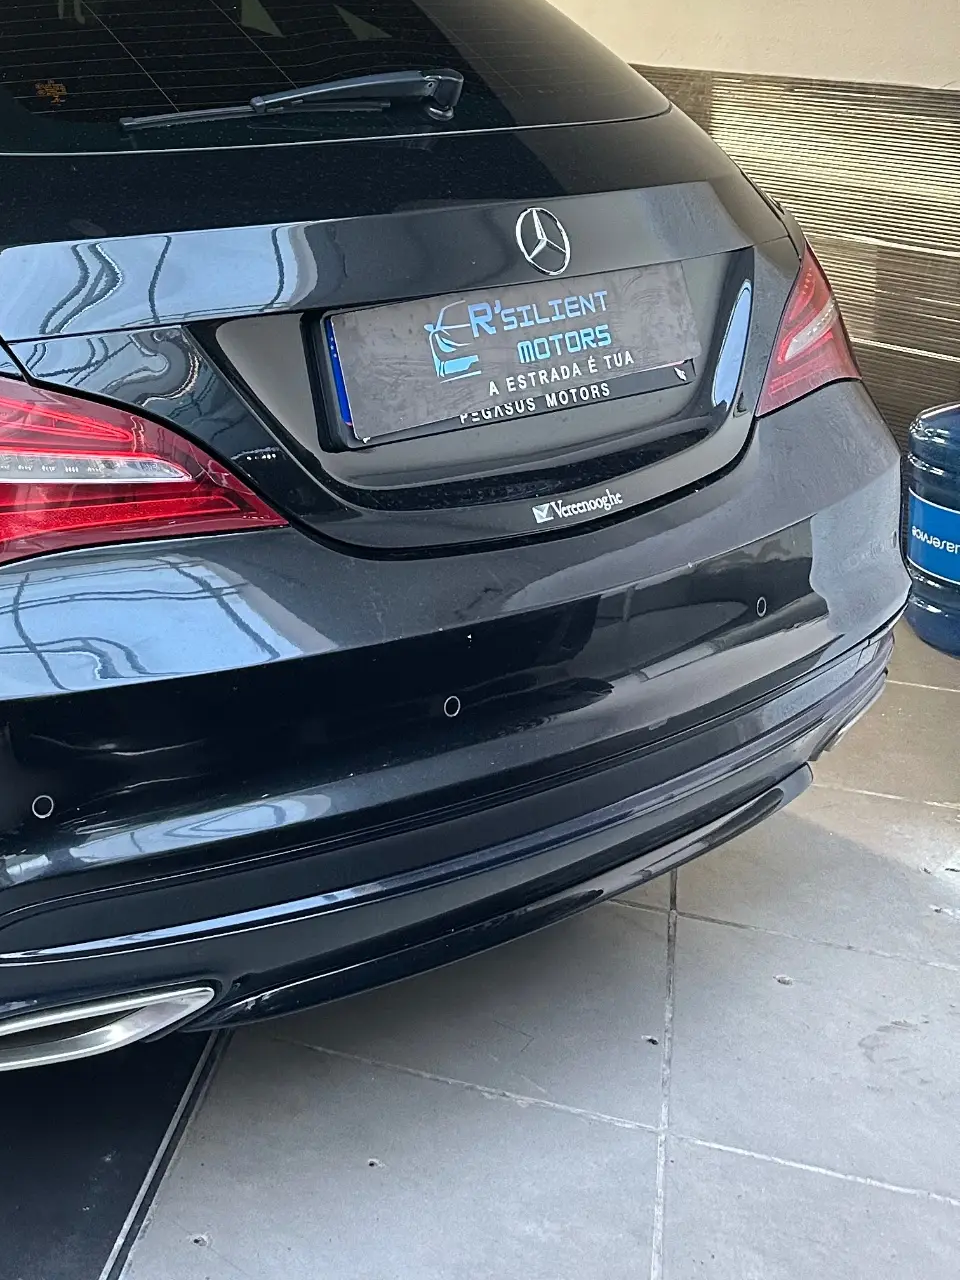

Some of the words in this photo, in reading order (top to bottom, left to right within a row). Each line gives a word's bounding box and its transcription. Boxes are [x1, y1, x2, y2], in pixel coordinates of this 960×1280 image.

[467, 290, 608, 338] R'SILIENT
[517, 324, 612, 364] MOTORS
[489, 380, 500, 396] A
[506, 365, 582, 393] ESTRADA
[587, 355, 598, 374] É
[603, 350, 635, 370] TUA
[546, 383, 610, 408] MOTORS
[550, 488, 623, 518] Vereenooghe
